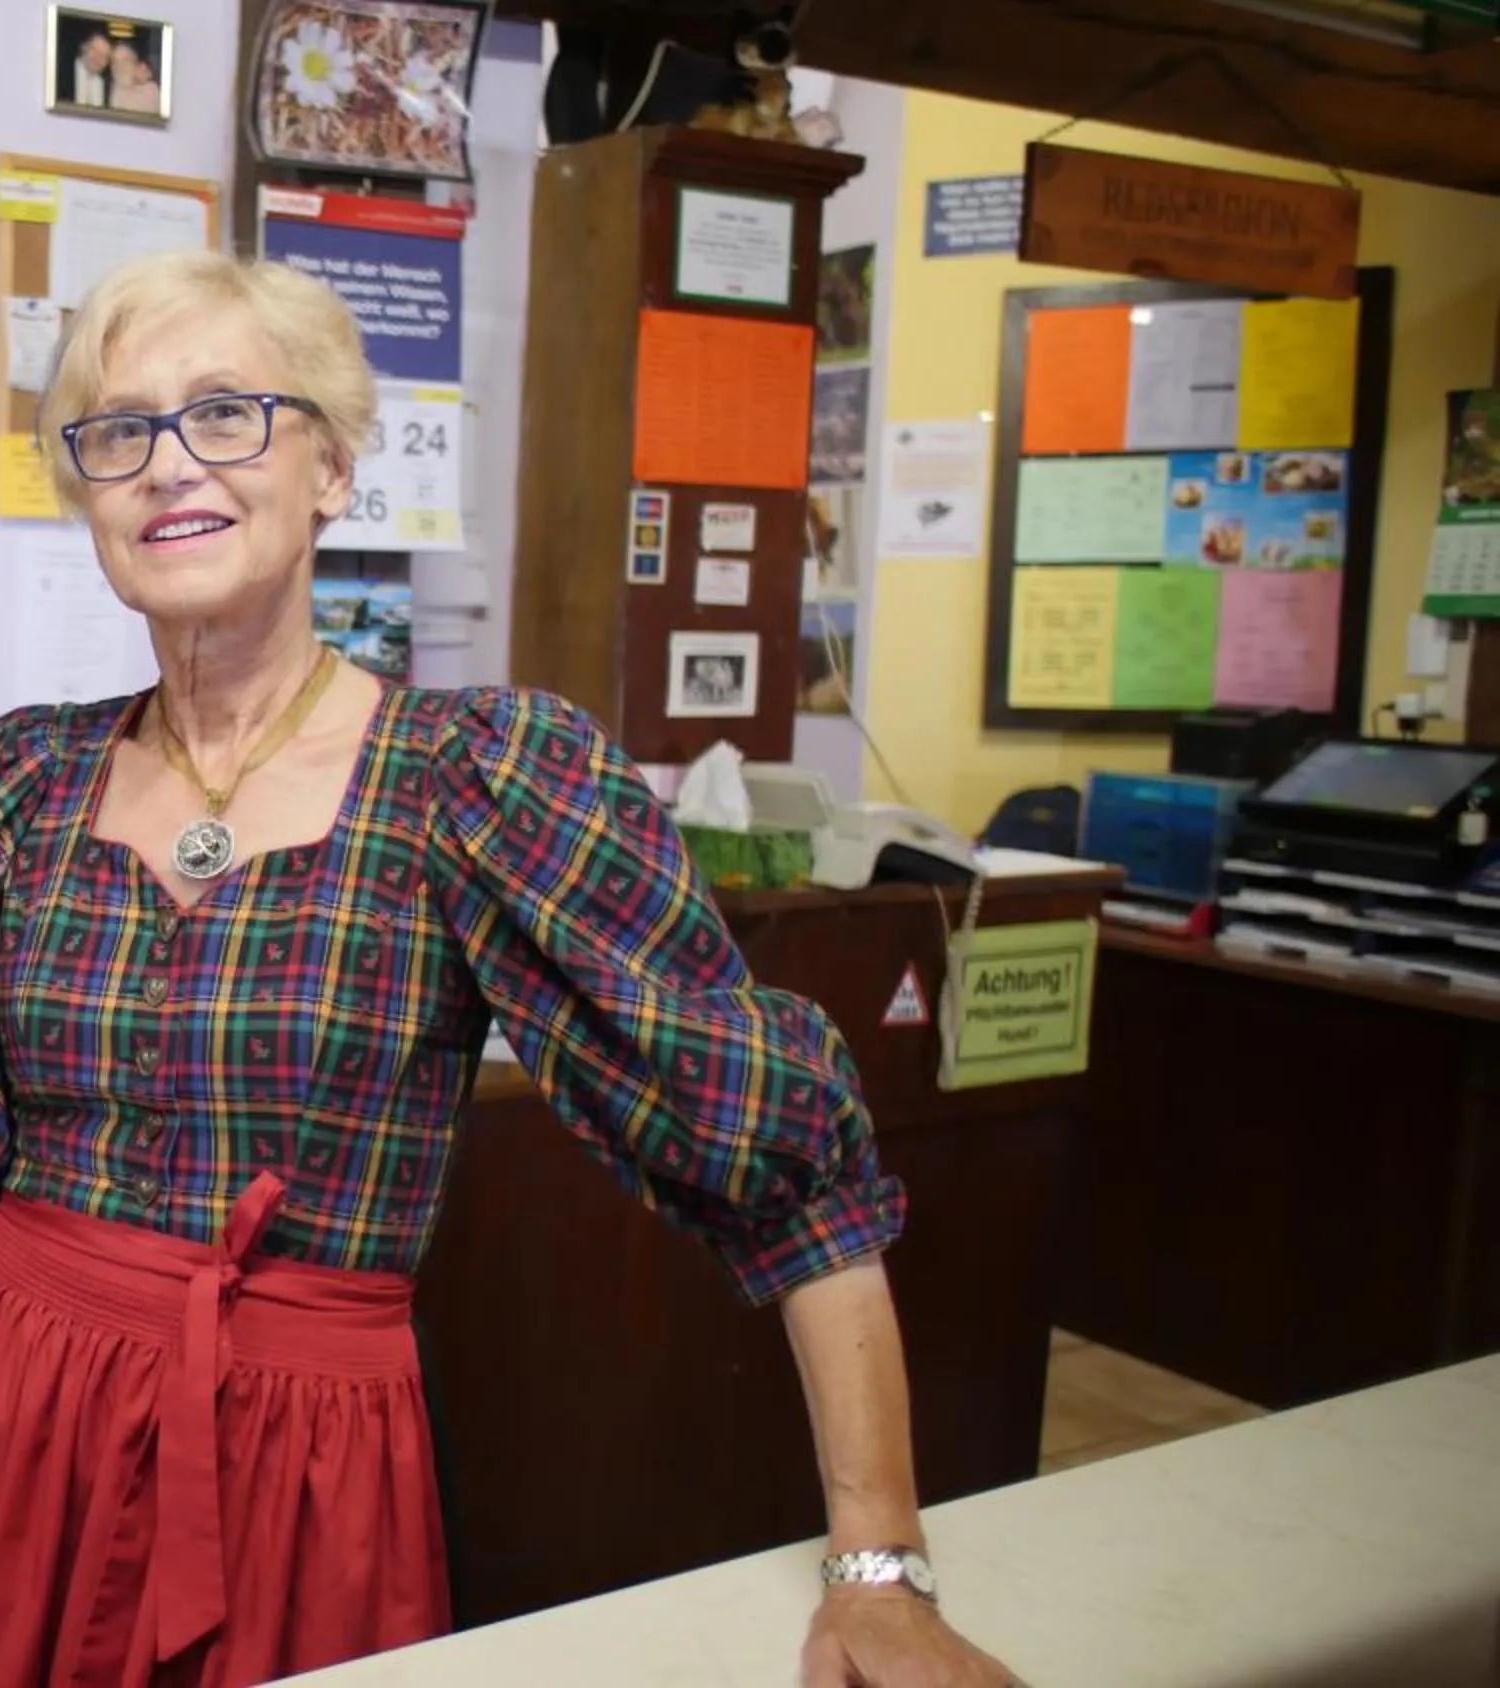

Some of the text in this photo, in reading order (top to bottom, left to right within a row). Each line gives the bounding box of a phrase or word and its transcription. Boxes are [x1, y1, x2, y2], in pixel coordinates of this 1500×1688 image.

[381, 263, 443, 284] Mensch
[403, 420, 449, 457] 24
[346, 487, 389, 523] 26
